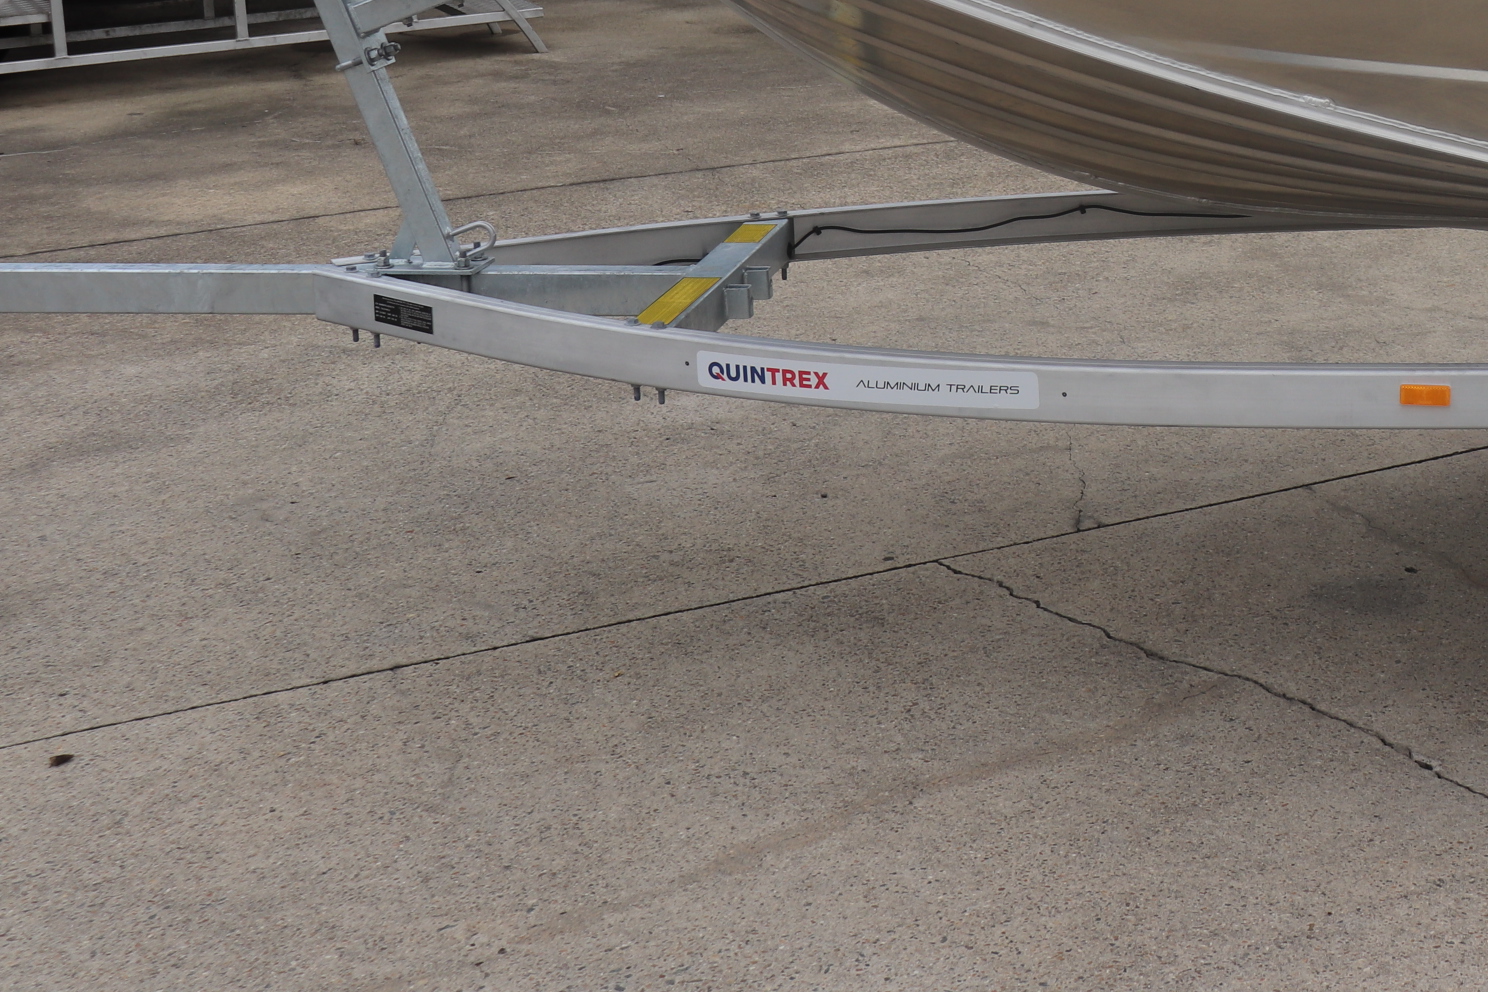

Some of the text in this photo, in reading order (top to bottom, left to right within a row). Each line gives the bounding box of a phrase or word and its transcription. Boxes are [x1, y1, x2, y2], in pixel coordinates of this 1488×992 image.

[708, 361, 1020, 395] QUINTREX ALUMINIUM TRAILERS
